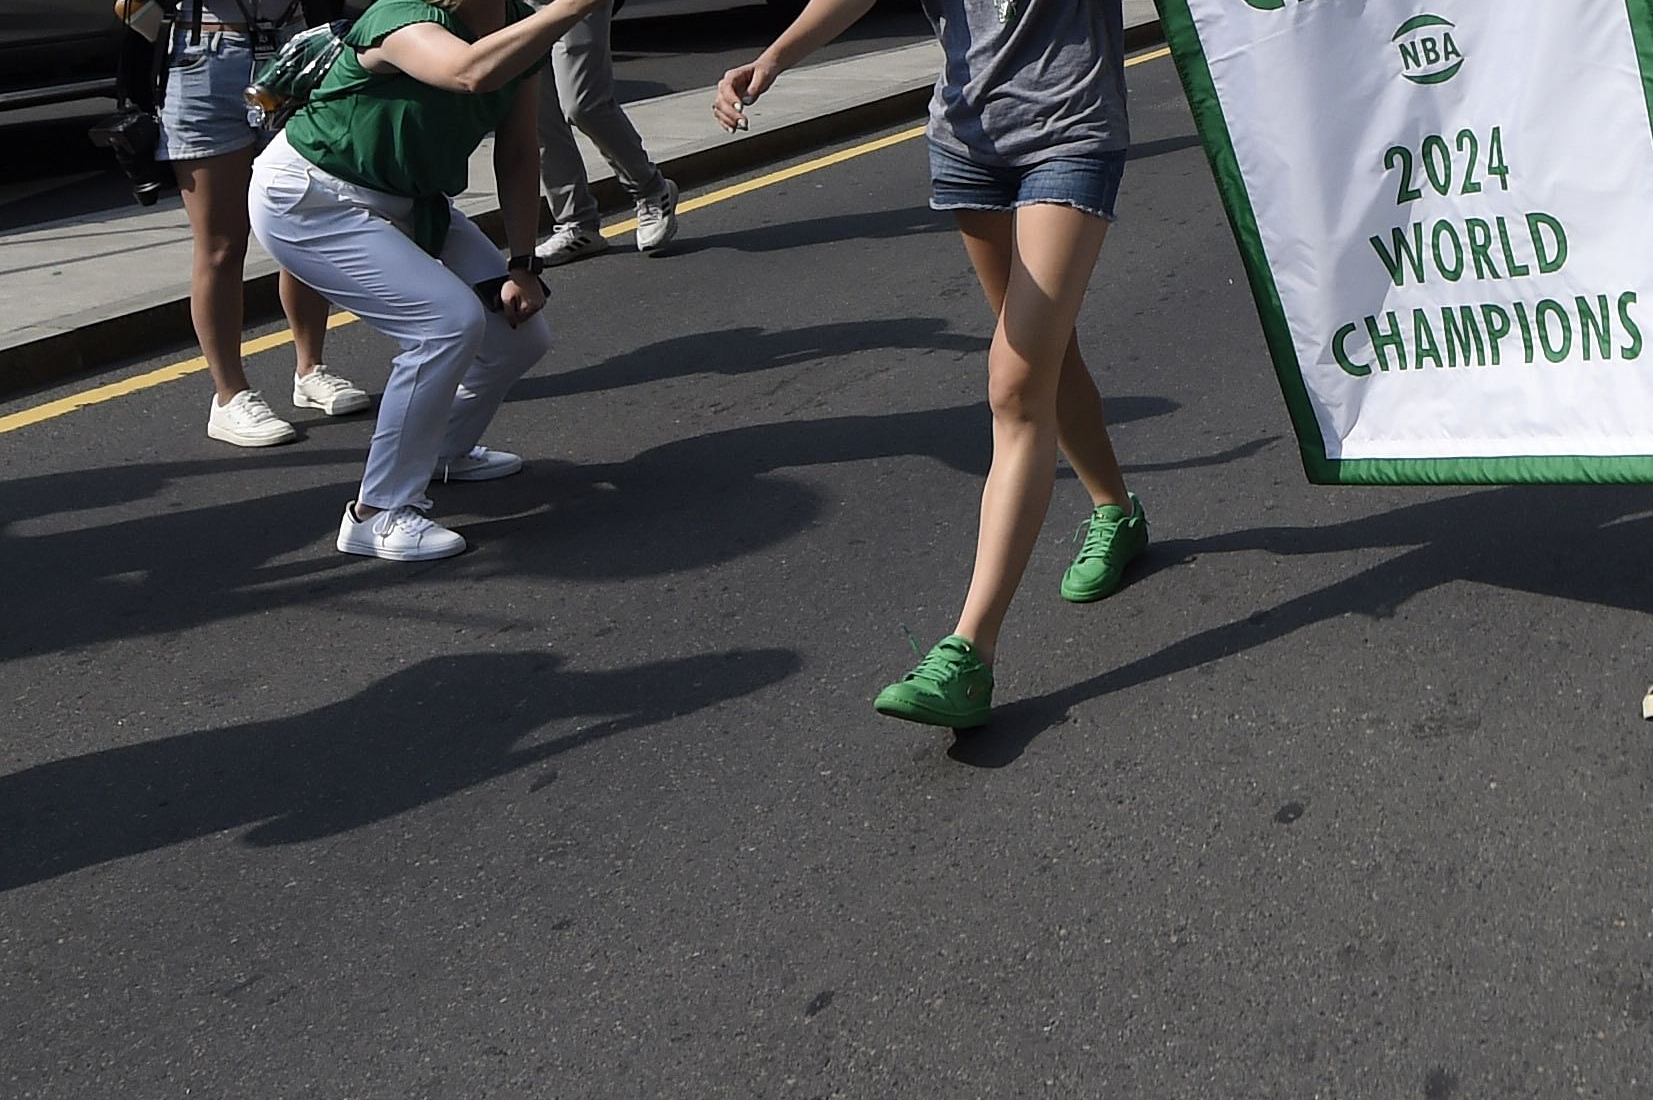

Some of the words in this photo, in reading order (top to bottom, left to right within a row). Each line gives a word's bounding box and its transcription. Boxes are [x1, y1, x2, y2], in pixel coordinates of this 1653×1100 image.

[1397, 32, 1463, 72] NBA
[1383, 125, 1510, 206] 2024
[1368, 211, 1569, 288] WORLD
[1330, 290, 1643, 378] CHAMPIONS
